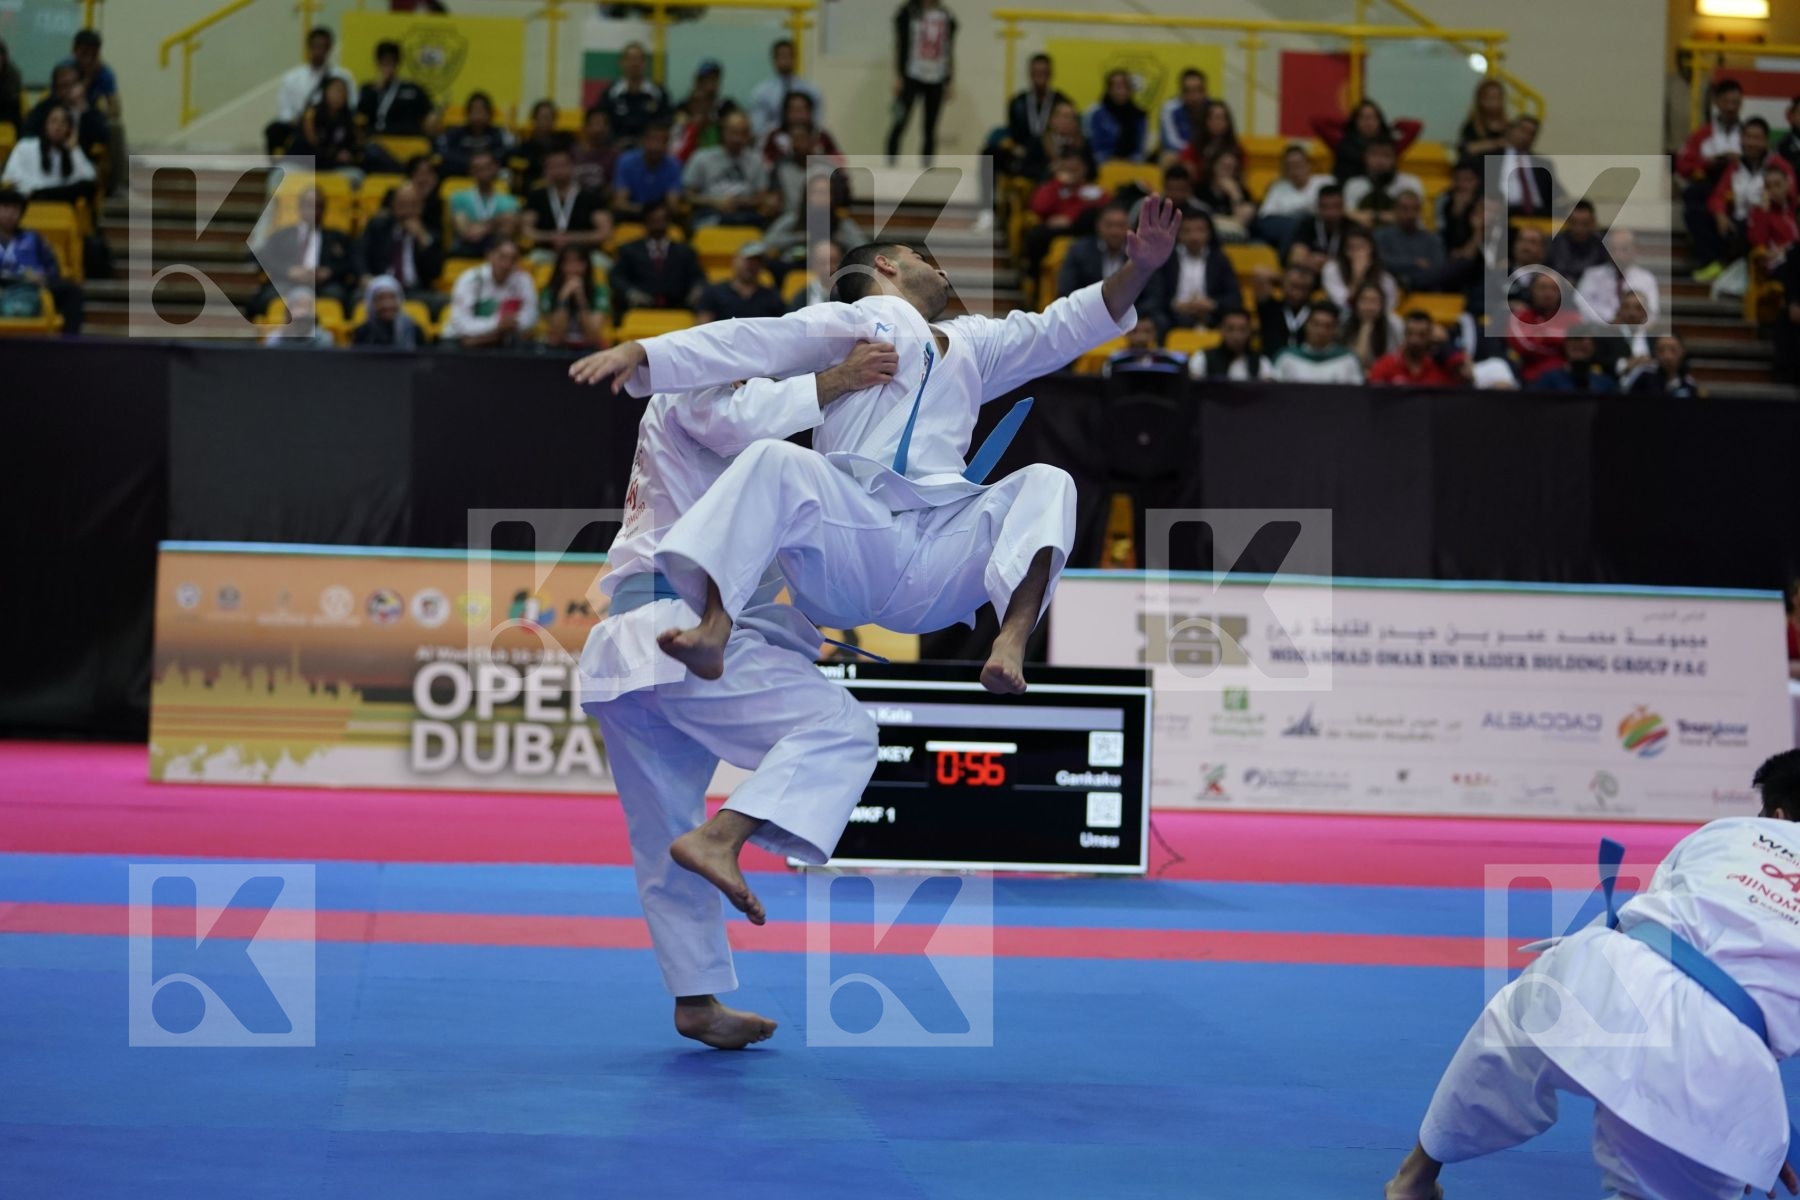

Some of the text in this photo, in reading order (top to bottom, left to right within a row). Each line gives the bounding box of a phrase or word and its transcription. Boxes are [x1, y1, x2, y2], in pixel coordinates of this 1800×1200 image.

[878, 707, 913, 723] Kata
[412, 719, 610, 777] DUBA
[936, 750, 1006, 786] 0:56
[1056, 769, 1122, 788] Gankaku
[886, 806, 896, 823] 1
[1080, 831, 1121, 849] Unsu
[1727, 873, 1800, 916] AJINOM
